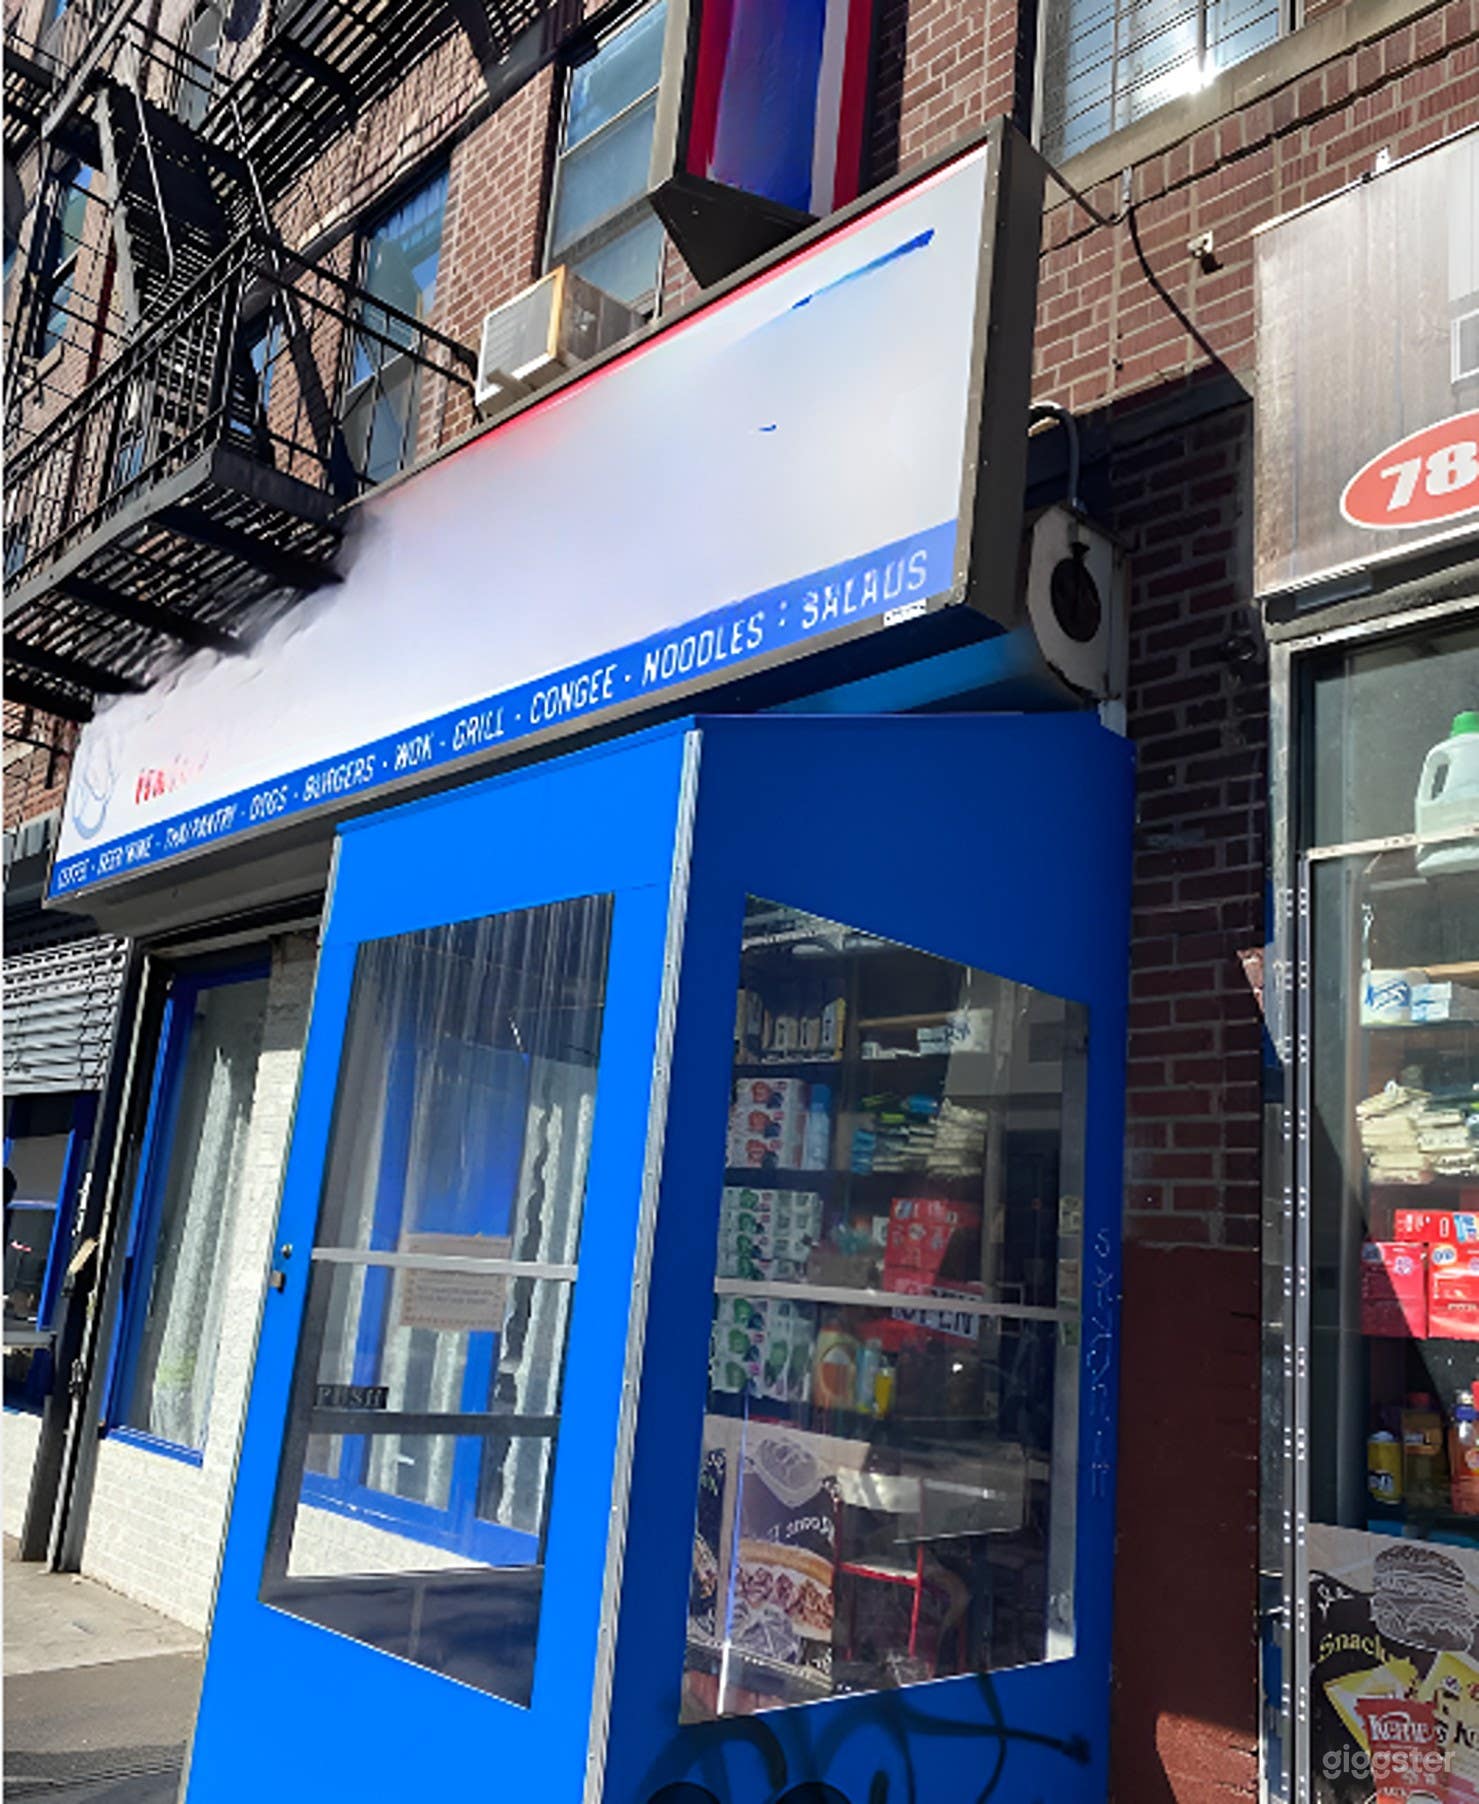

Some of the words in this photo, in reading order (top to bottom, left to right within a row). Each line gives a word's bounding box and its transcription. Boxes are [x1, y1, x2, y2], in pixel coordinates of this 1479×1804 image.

[1380, 441, 1478, 512] 78
[453, 706, 504, 752] GRILL
[530, 663, 618, 725] CONGEE
[641, 610, 765, 687] NOODLES
